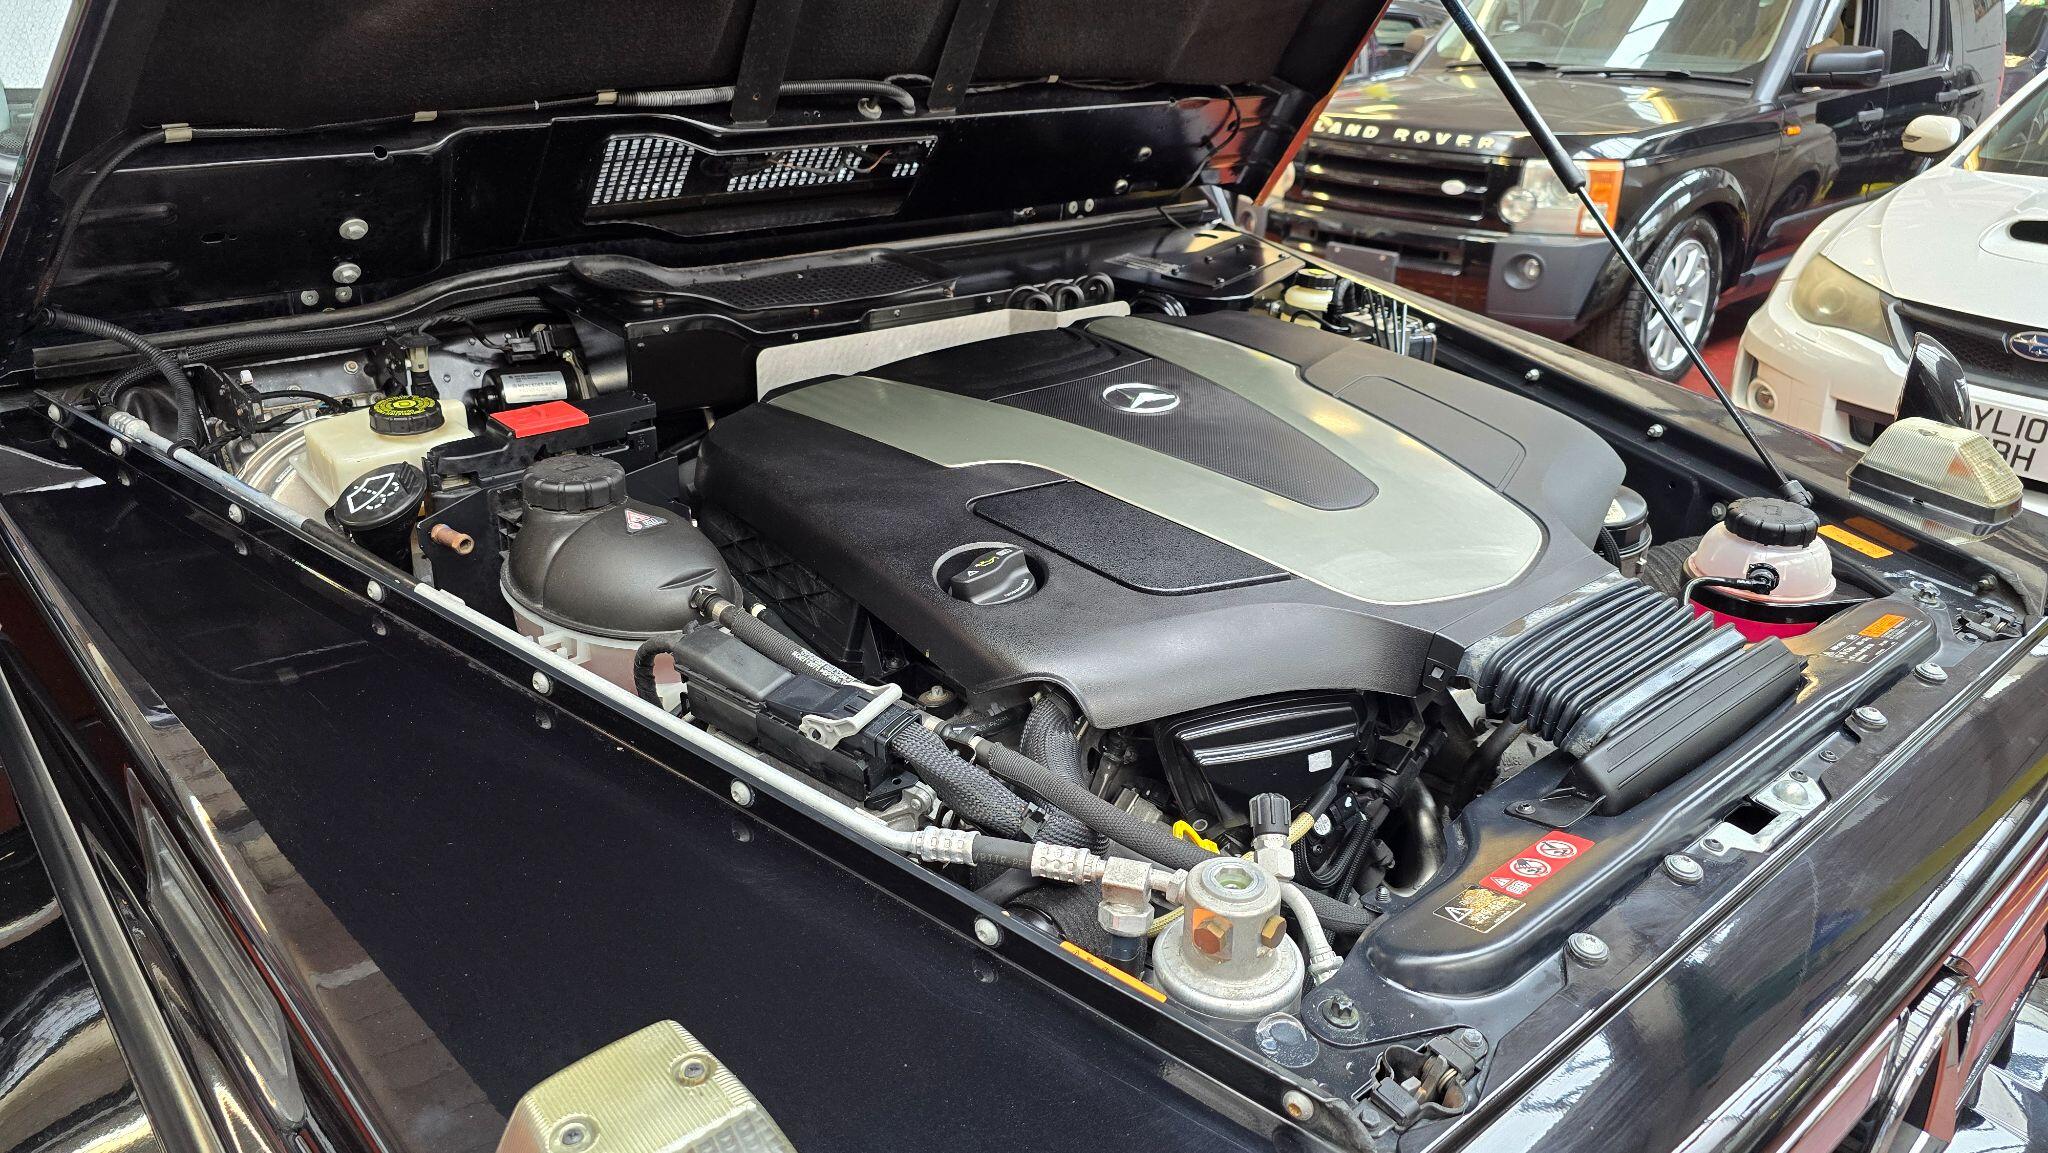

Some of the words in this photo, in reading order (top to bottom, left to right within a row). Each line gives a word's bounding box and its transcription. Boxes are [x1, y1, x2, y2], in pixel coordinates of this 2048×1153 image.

[1313, 119, 1380, 139] LAND
[1393, 127, 1496, 149] ROVER
[1974, 404, 2048, 444] YL10
[1985, 436, 2036, 472] BH
